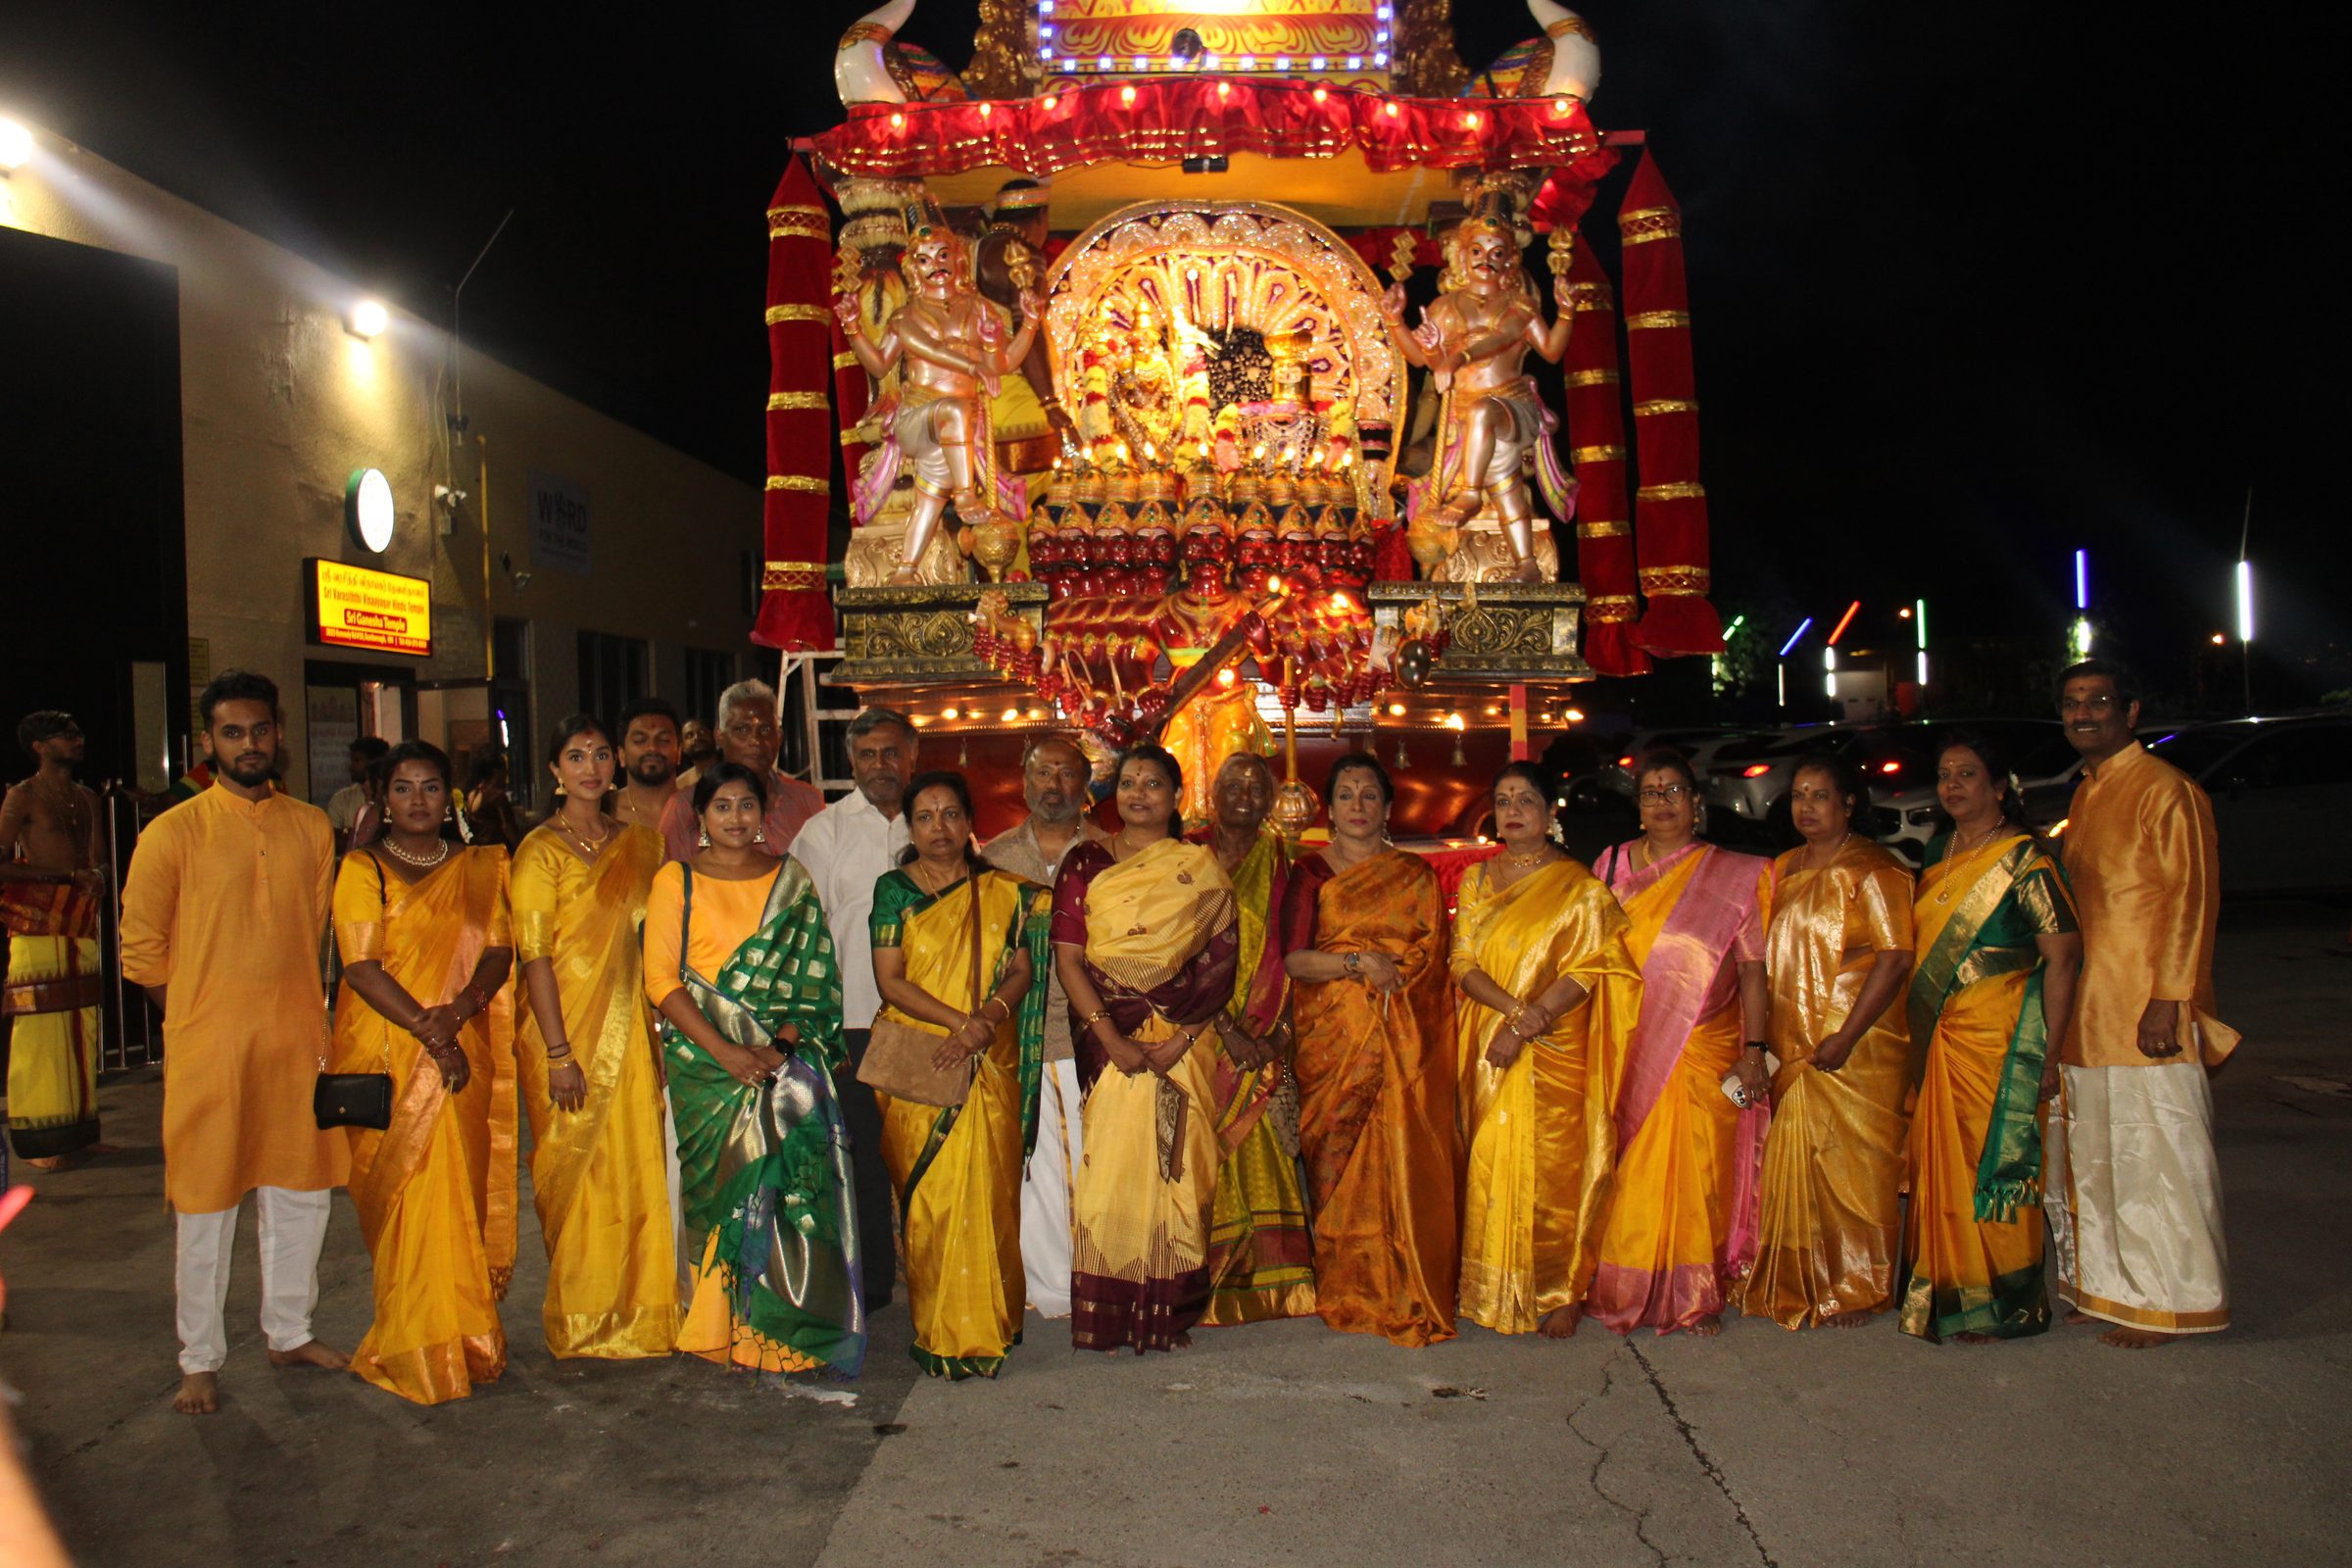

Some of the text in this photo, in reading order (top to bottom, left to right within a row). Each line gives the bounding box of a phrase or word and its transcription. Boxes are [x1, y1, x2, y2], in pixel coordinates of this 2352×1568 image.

[392, 599, 406, 612] Hindu
[408, 601, 423, 614] Temple
[347, 610, 405, 632] Sri Ganesha Temple
